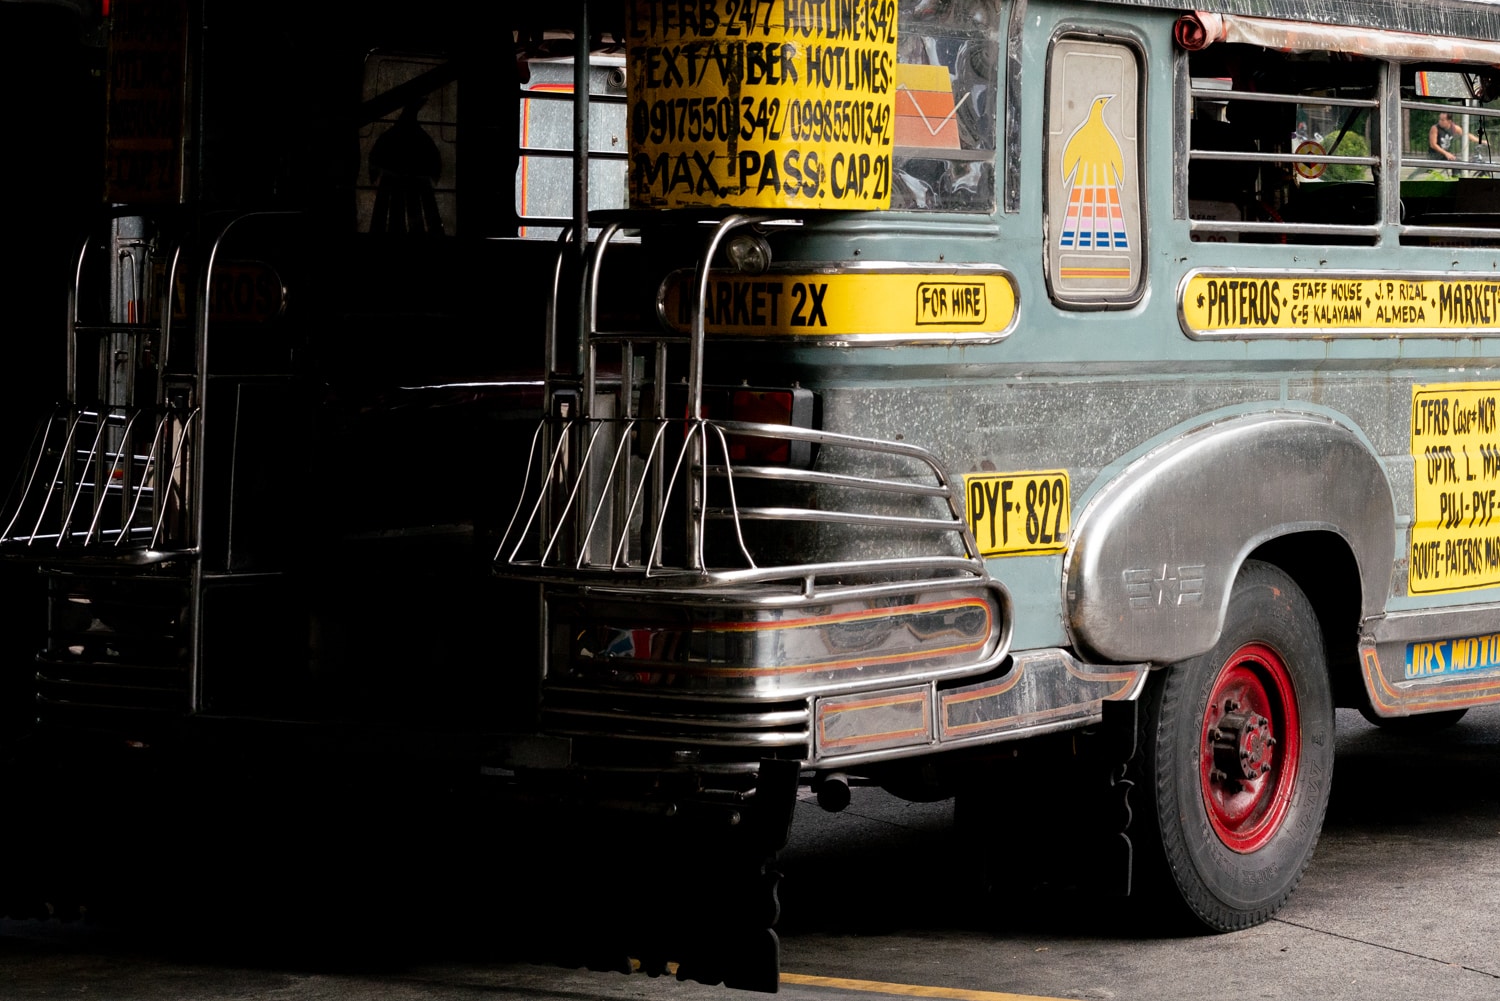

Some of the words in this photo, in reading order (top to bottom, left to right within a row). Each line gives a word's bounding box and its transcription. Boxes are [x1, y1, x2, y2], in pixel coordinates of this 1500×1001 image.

[806, 44, 893, 95] HOTLINES:
[873, 154, 890, 200] 21
[791, 283, 828, 327] 2X
[922, 286, 947, 317] FOR
[952, 287, 981, 318] HIRE
[1207, 280, 1280, 326] PATEROS
[1292, 282, 1327, 301] STAFF
[1332, 282, 1362, 302] HOUSE
[1399, 283, 1427, 301] RIZAL
[1439, 284, 1498, 325] MARKET
[1314, 305, 1362, 325] KALAYAAN
[1376, 305, 1425, 323] ALMEDA
[1414, 398, 1450, 436] LTFRB
[1477, 396, 1496, 434] NCR
[1424, 446, 1460, 485] OPTR.
[1463, 445, 1476, 481] L.
[1406, 641, 1447, 678] JRS
